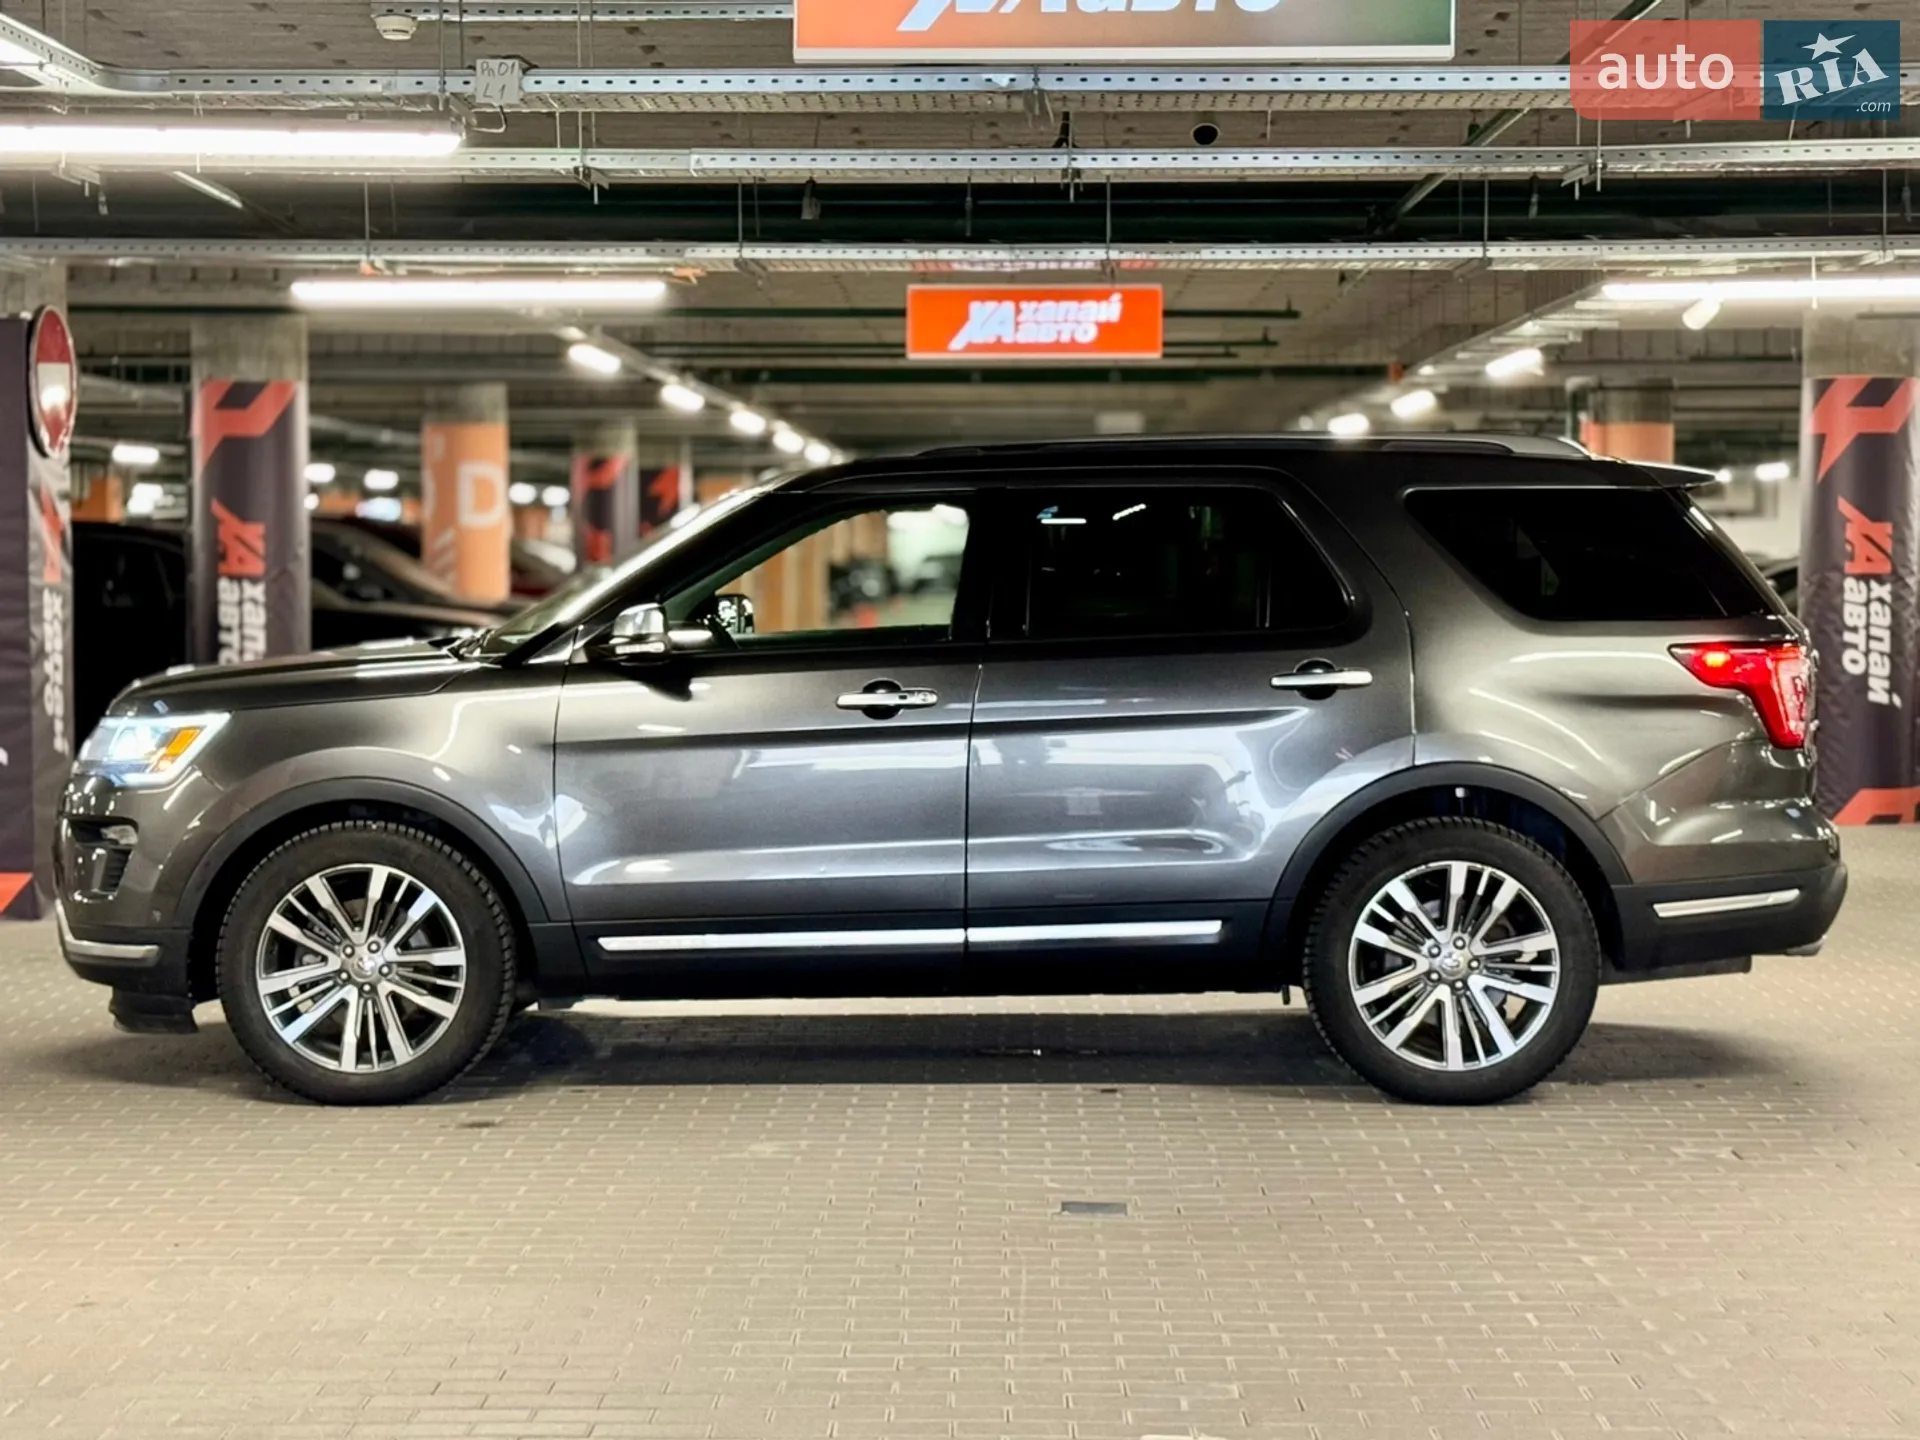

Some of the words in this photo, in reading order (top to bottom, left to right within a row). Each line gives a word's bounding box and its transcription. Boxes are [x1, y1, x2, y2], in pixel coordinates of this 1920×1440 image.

[1015, 322, 1098, 344] авто
[1841, 577, 1868, 676] авто
[1867, 579, 1902, 709] хапай
